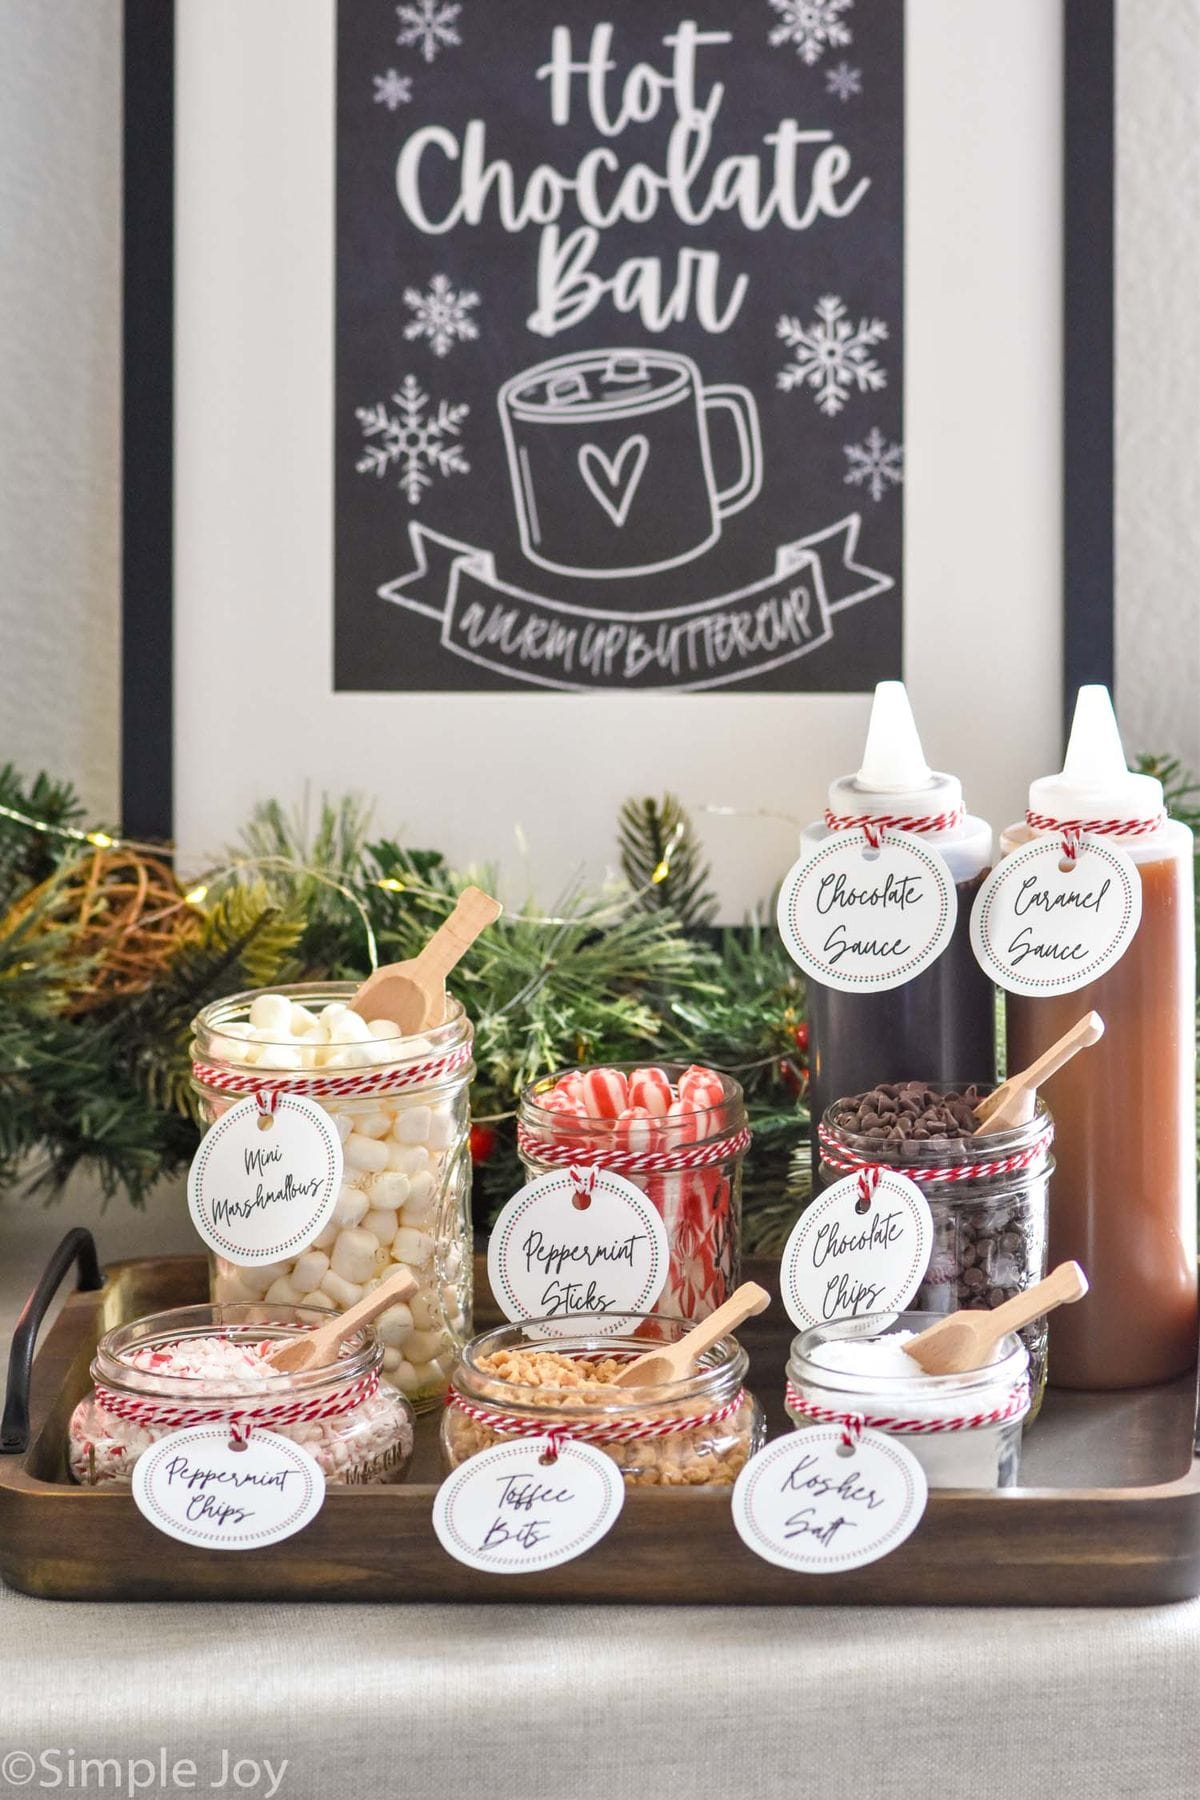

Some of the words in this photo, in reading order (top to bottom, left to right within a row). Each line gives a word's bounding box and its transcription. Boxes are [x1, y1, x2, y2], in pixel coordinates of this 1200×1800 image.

[536, 20, 732, 136] Hot
[396, 116, 871, 234] Chocolate
[526, 223, 748, 336] Bar
[816, 873, 924, 914] Chocolate
[1014, 876, 1111, 916] Caramel
[823, 925, 911, 964] Sauce
[1008, 927, 1089, 966] Sauce
[244, 1144, 283, 1177] Mini
[211, 1173, 325, 1227] Marshmallows
[522, 1230, 647, 1275] Peppermint
[812, 1211, 904, 1268] Chocolate
[541, 1280, 616, 1317] Sticks
[822, 1273, 886, 1320] Chips
[165, 1455, 300, 1492] Peppermint
[496, 1474, 576, 1511] Toffee
[781, 1454, 885, 1509] Kosher
[185, 1495, 255, 1526] Chips
[784, 1508, 857, 1548] Salt
[478, 1517, 550, 1551] Bits
